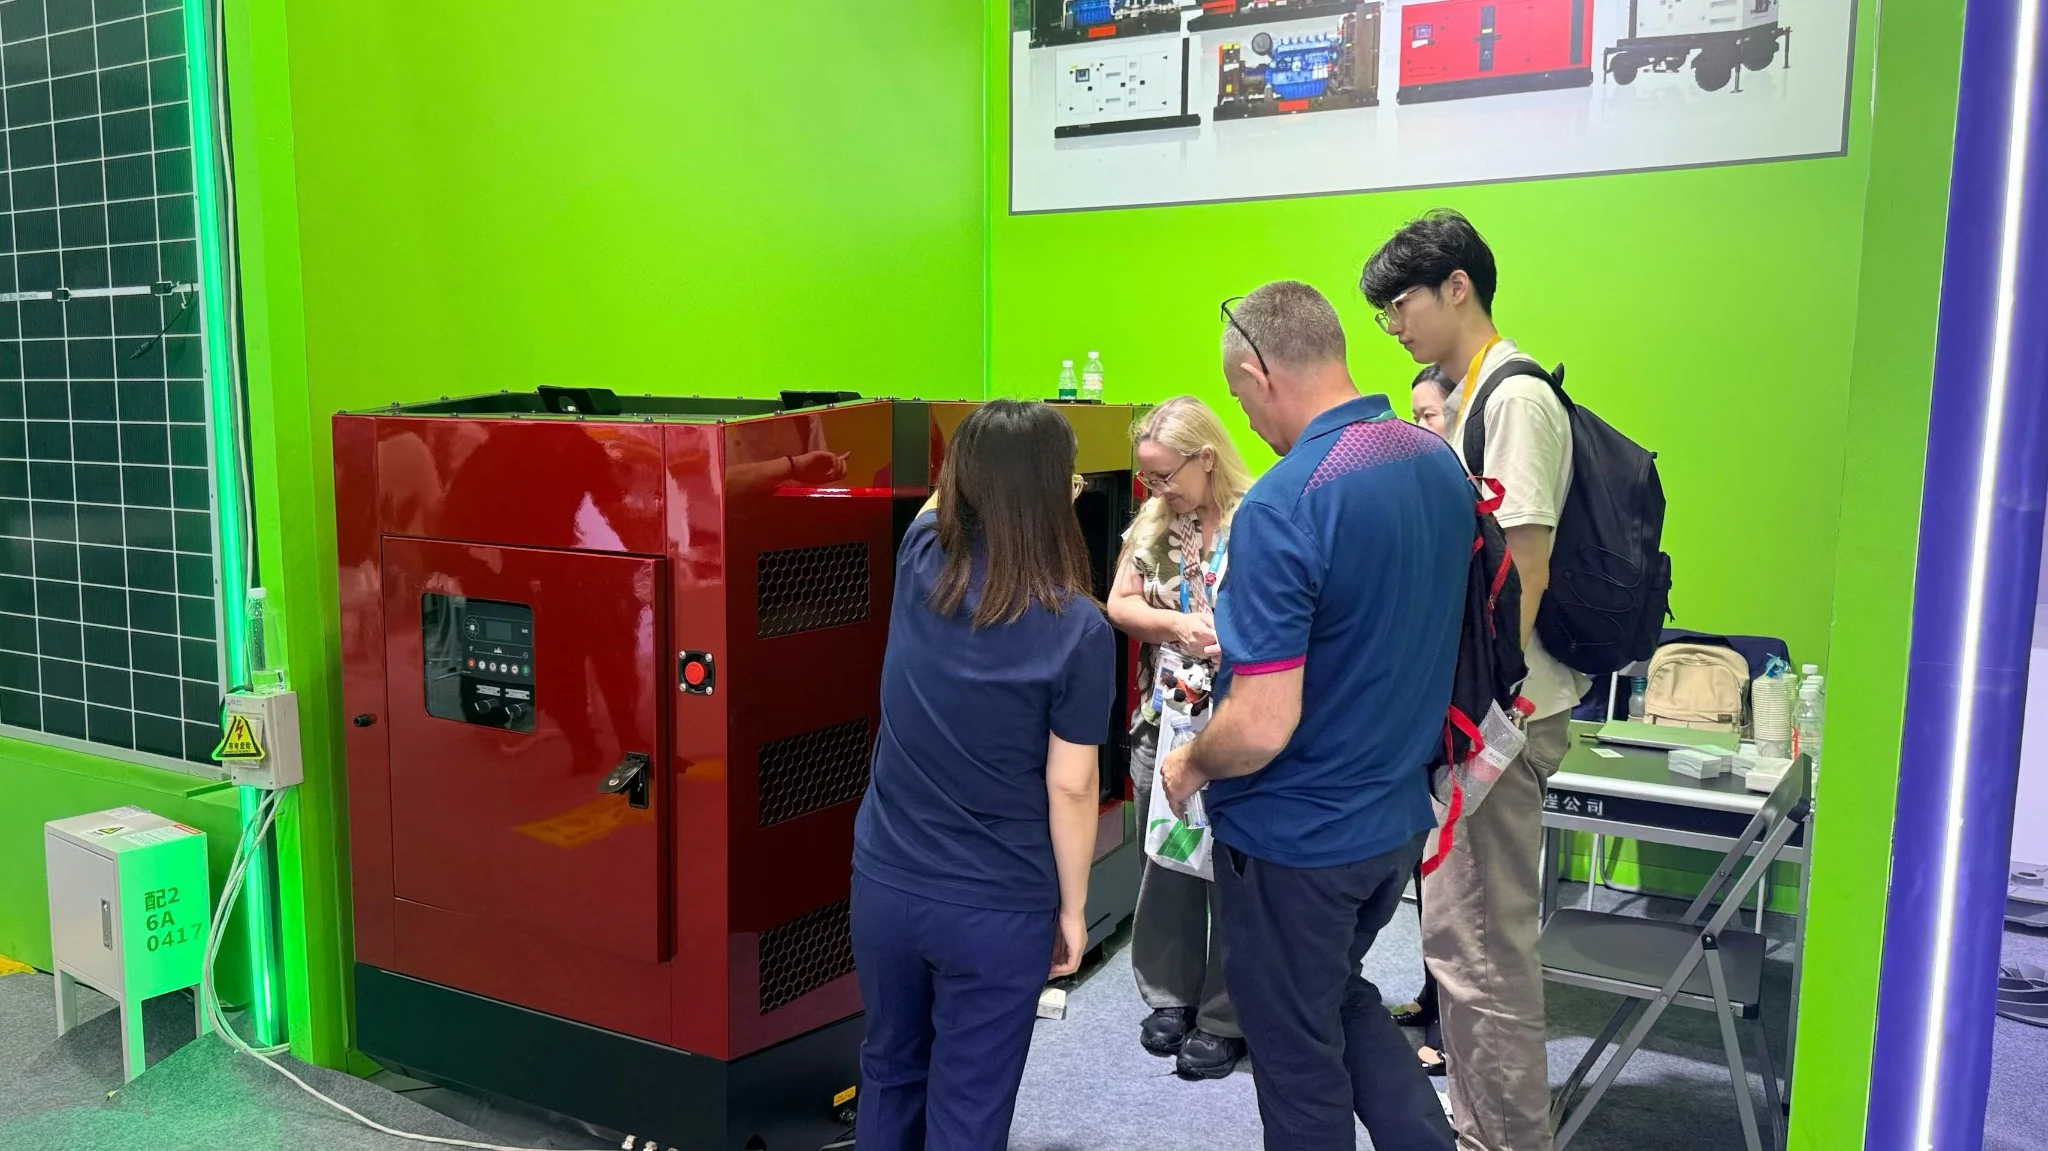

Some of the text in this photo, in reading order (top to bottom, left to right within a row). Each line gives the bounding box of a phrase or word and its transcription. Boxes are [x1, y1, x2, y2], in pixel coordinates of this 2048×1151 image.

[144, 887, 180, 912] 配2
[146, 911, 175, 931] 6A
[147, 922, 202, 952] 0417
